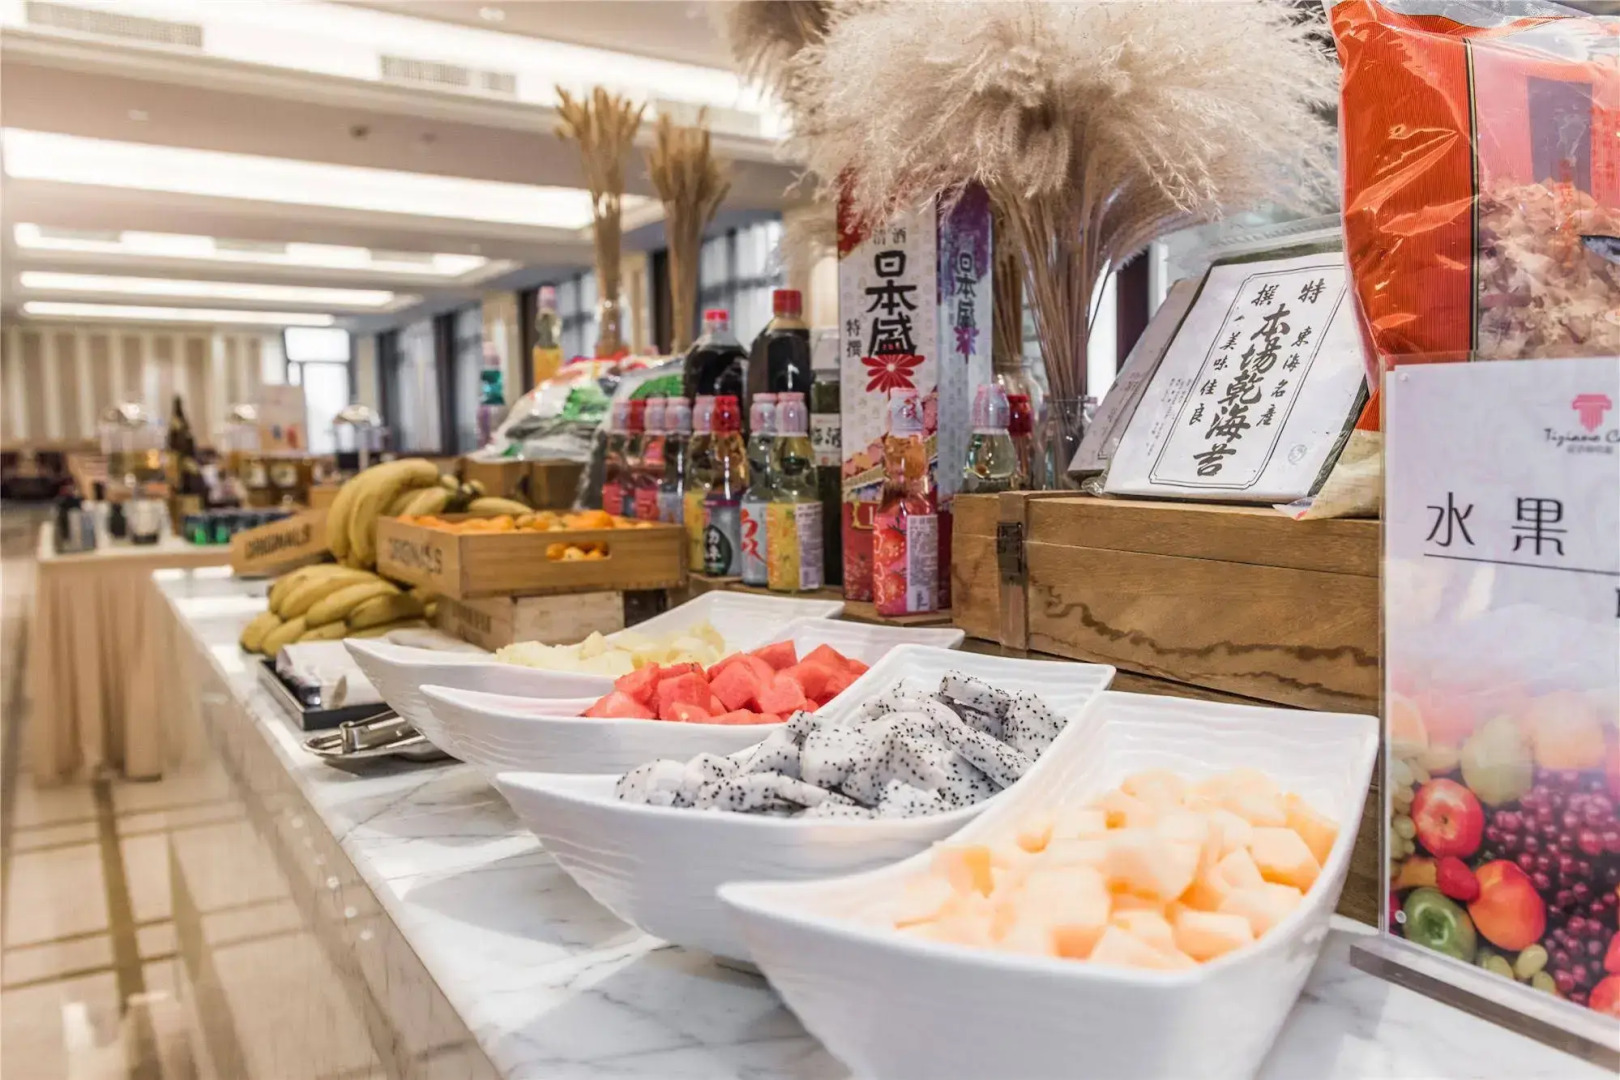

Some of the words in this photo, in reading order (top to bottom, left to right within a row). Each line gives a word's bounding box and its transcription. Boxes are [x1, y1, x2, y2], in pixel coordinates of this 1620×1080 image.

[864, 250, 919, 358] 日本盛
[1426, 491, 1569, 556] 水果
